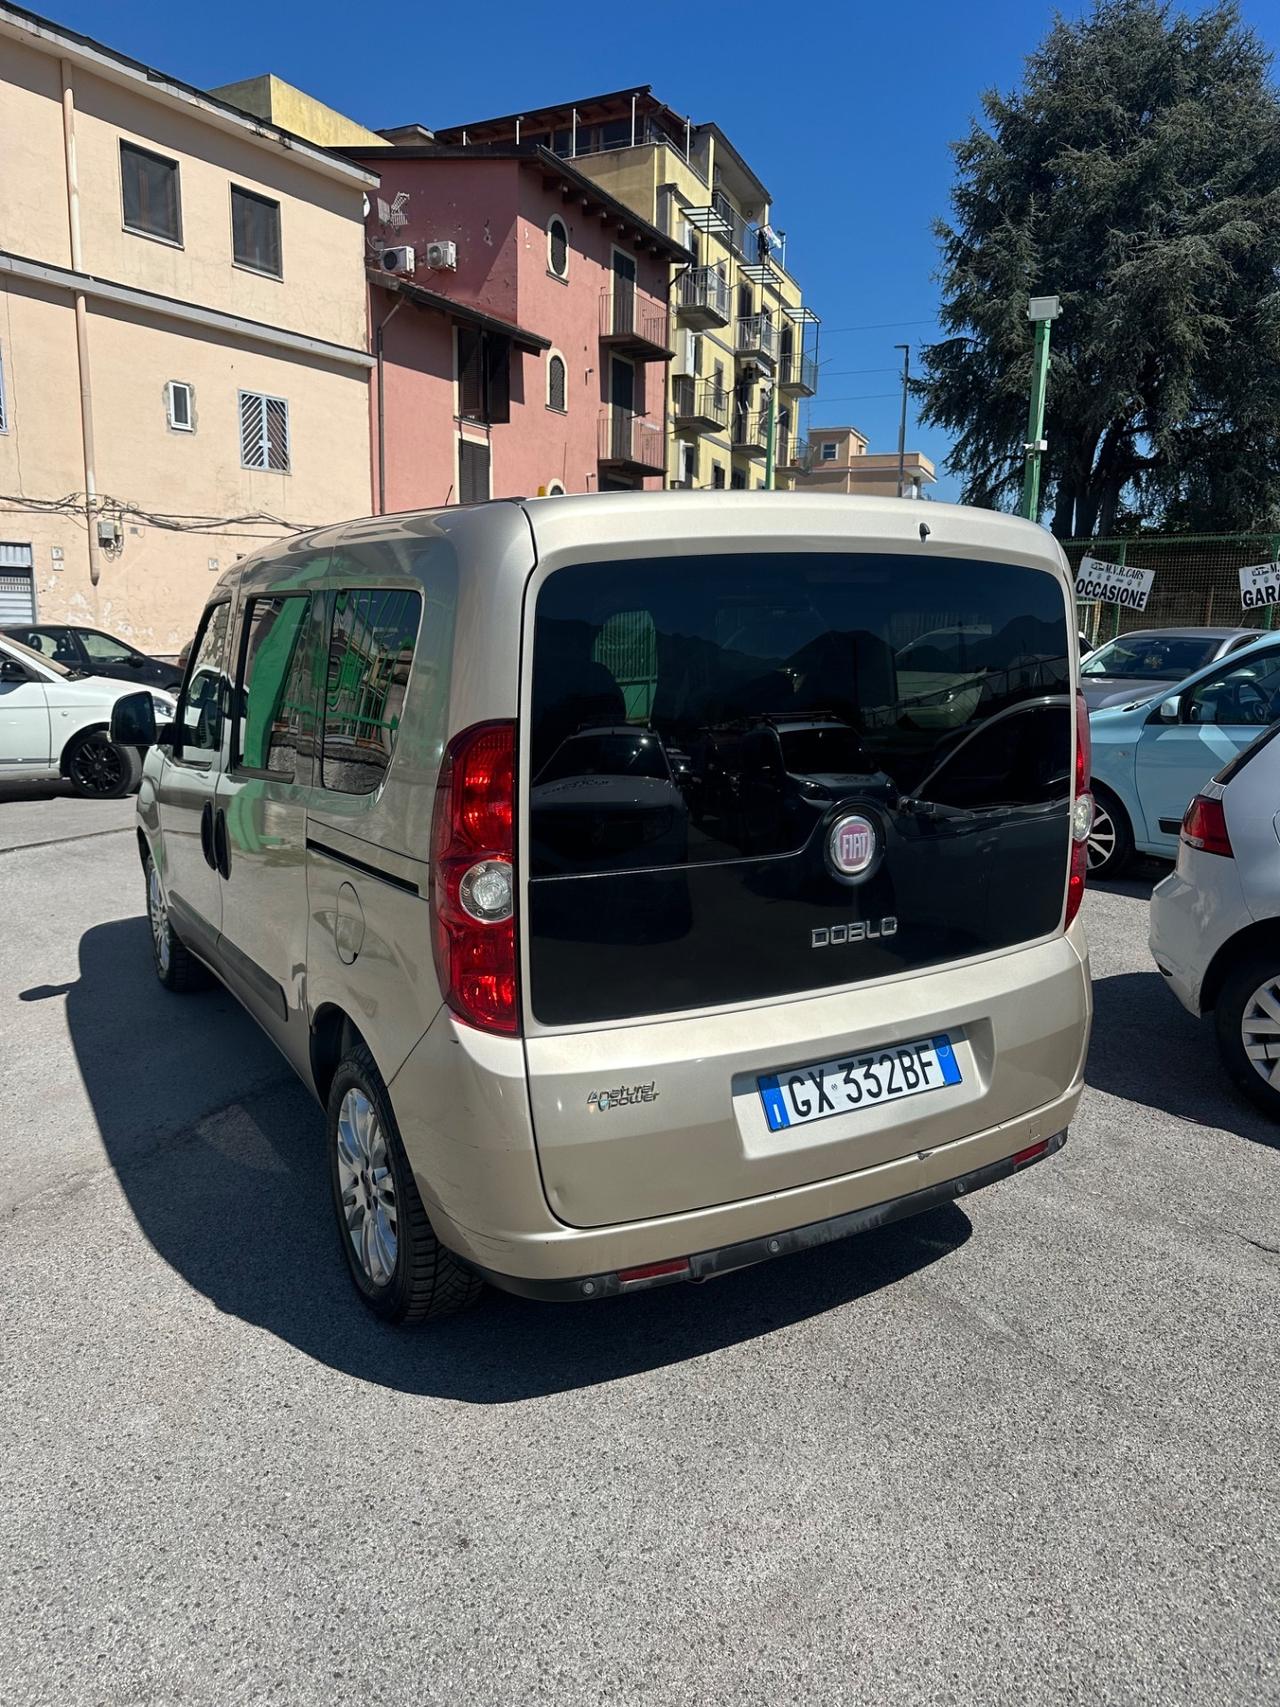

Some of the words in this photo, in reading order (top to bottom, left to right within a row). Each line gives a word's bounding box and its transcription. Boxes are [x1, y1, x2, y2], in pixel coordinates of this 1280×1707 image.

[1076, 578, 1146, 608] OCCASIONE
[1243, 584, 1280, 607] GAR
[841, 832, 868, 860] FIAT
[811, 916, 898, 948] DOBLO
[599, 1080, 656, 1100] natural
[788, 1068, 836, 1117] GX
[837, 1044, 934, 1104] 332BF
[607, 1092, 661, 1111] power
